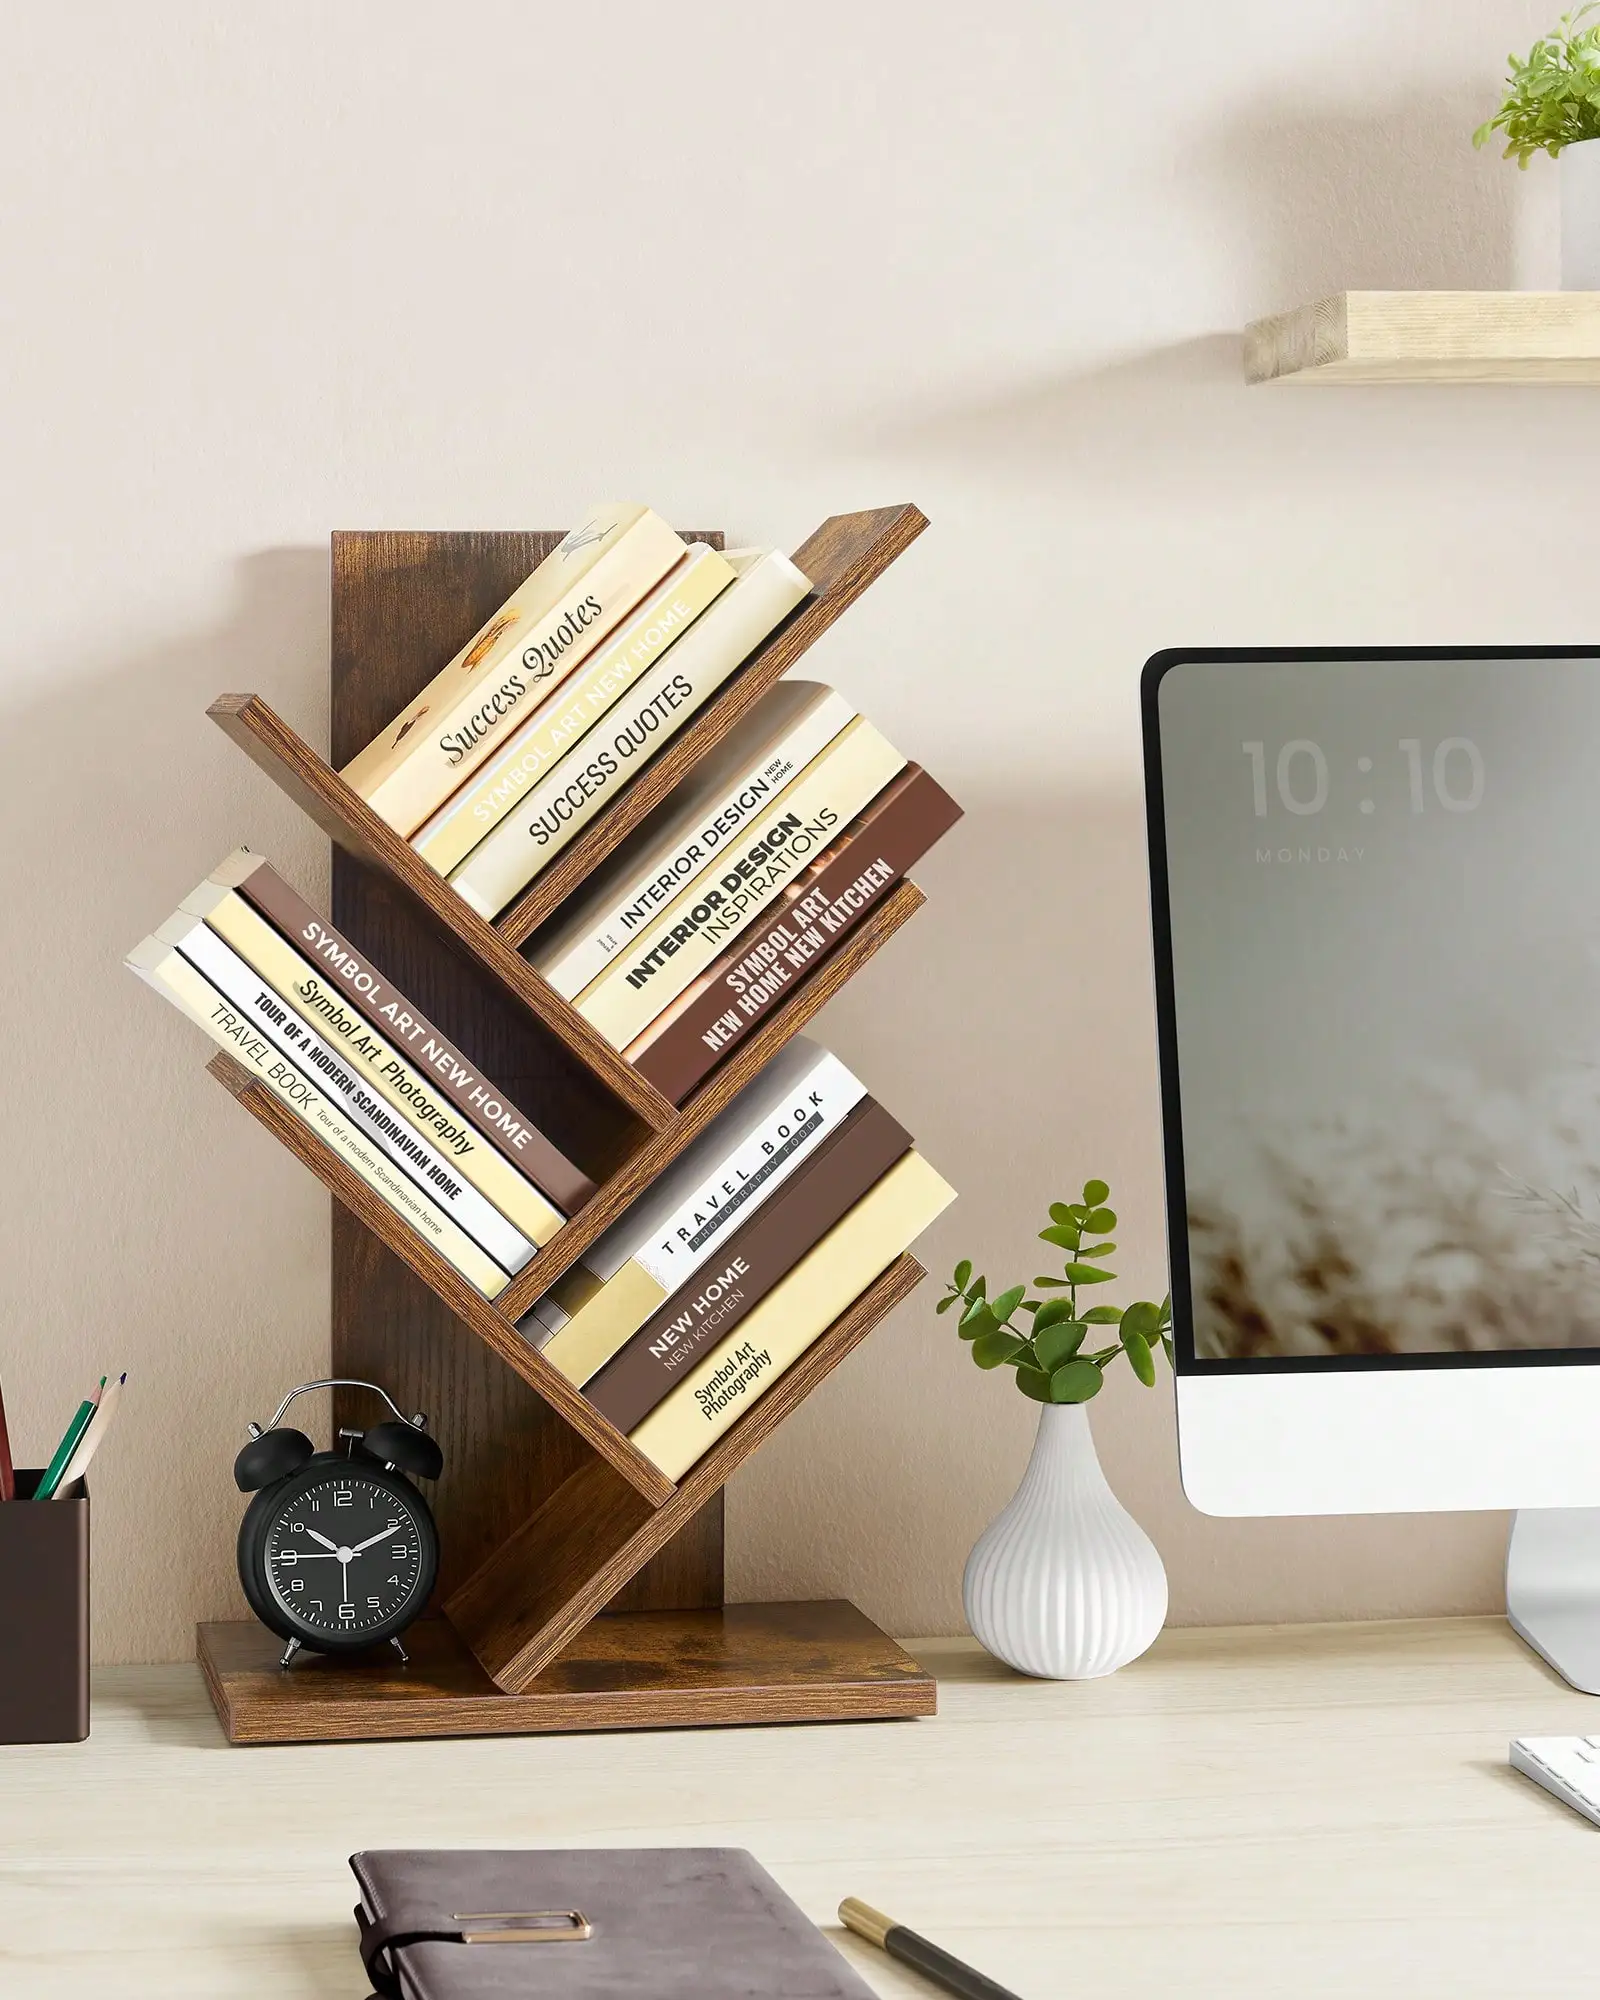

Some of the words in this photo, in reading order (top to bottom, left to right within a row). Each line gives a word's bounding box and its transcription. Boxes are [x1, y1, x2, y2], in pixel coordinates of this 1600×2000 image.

[439, 675, 527, 765] Success
[522, 595, 602, 683] Quotes
[473, 746, 550, 822] SYMBOL
[550, 706, 587, 745] ART
[585, 661, 632, 700] NEW
[631, 599, 691, 660] HOME
[529, 752, 618, 846] SUCCESS
[614, 674, 693, 758] QUOTES
[764, 758, 782, 777] NEW
[771, 761, 794, 784] HOME
[620, 845, 706, 929] INTERIOR
[701, 778, 770, 848] DESIGN
[700, 807, 838, 944] INSPIRATIONS
[1256, 847, 1365, 865] MONDAY
[625, 890, 728, 990] INTERIOR
[719, 813, 803, 893] DESIGN
[726, 924, 797, 993] SYMBOL
[792, 886, 832, 928] ART
[701, 1009, 744, 1052] NEW
[736, 964, 792, 1016] HOME
[783, 926, 826, 970] NEW
[818, 858, 895, 933] KITCHEN
[211, 1002, 269, 1067] TRAVEL
[267, 1062, 318, 1110] BOOK
[300, 980, 361, 1037] Symbol
[352, 1035, 382, 1062] Art
[380, 1061, 475, 1156] Photography
[302, 922, 381, 1004] SYMBOL
[379, 1002, 426, 1041] ART
[421, 1039, 474, 1088] NEW
[468, 1086, 535, 1151] HOME
[254, 992, 287, 1027] TOUR
[283, 1022, 303, 1041] OF
[297, 1038, 311, 1052] A
[307, 1046, 357, 1095] MODERN
[352, 1091, 432, 1170] SCANDINAVIAN
[427, 1164, 463, 1201] HOME
[316, 1108, 335, 1128] Tour
[332, 1126, 345, 1136] of
[346, 1140, 376, 1170] modern
[374, 1167, 421, 1218] Scandinavian
[419, 1212, 442, 1235] home
[662, 1169, 749, 1255] TRAVEL
[761, 1091, 823, 1155] BOOK
[693, 1158, 778, 1246] PHOTOGRAPHY
[783, 1121, 815, 1154] FOOD
[648, 1311, 694, 1359] NEW
[692, 1256, 750, 1316] HOME
[663, 1338, 694, 1371] NEW
[692, 1289, 745, 1342] KITCHEN
[694, 1358, 738, 1404] Symbol
[734, 1341, 756, 1365] Art
[702, 1349, 772, 1421] Photography
[290, 1522, 305, 1533] 10
[312, 1500, 320, 1512] 11
[333, 1490, 353, 1507] 12
[387, 1518, 399, 1529] 2
[280, 1550, 297, 1566] 9
[291, 1579, 304, 1591] 8
[387, 1574, 399, 1585] 4
[391, 1545, 407, 1559] 3
[310, 1600, 322, 1611] 7
[338, 1603, 355, 1619] 6
[367, 1597, 379, 1608] 5
